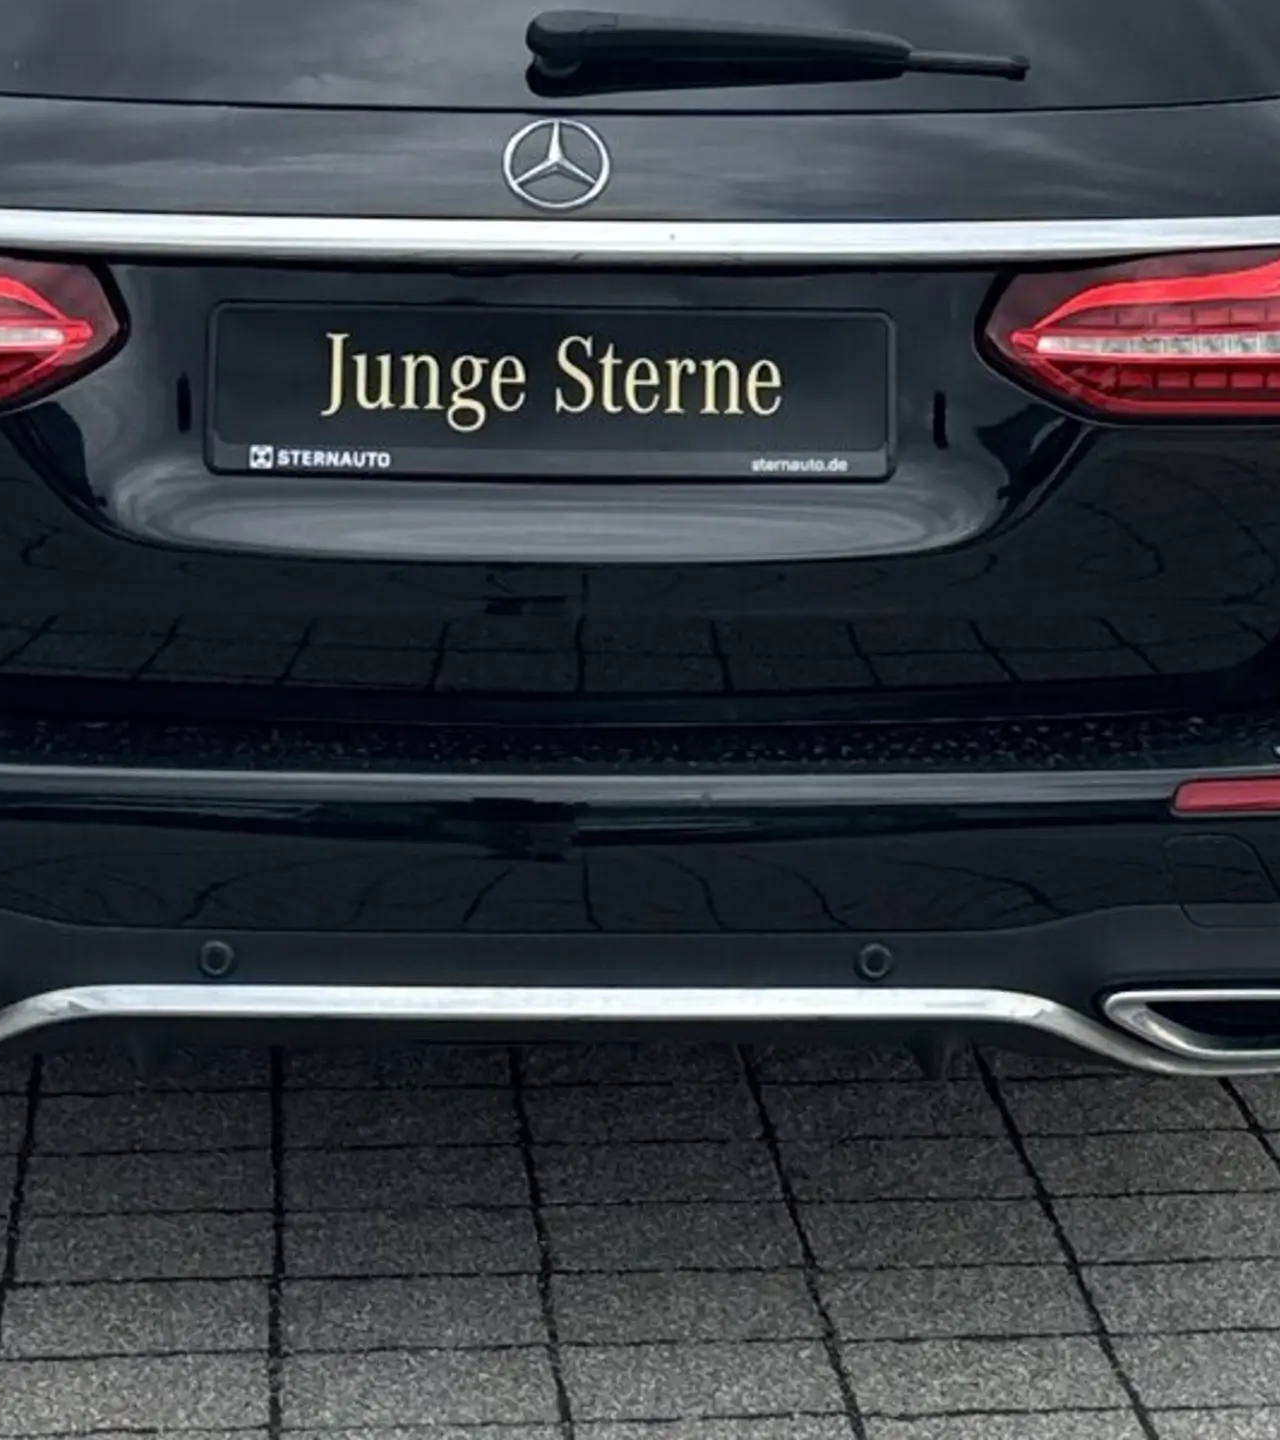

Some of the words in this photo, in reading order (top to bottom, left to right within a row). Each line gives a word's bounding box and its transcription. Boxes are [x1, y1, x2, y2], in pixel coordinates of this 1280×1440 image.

[321, 332, 526, 432] Junge
[555, 335, 782, 416] Sterne
[277, 448, 391, 468] STERNAUTO
[751, 456, 849, 472] sternauto.de
